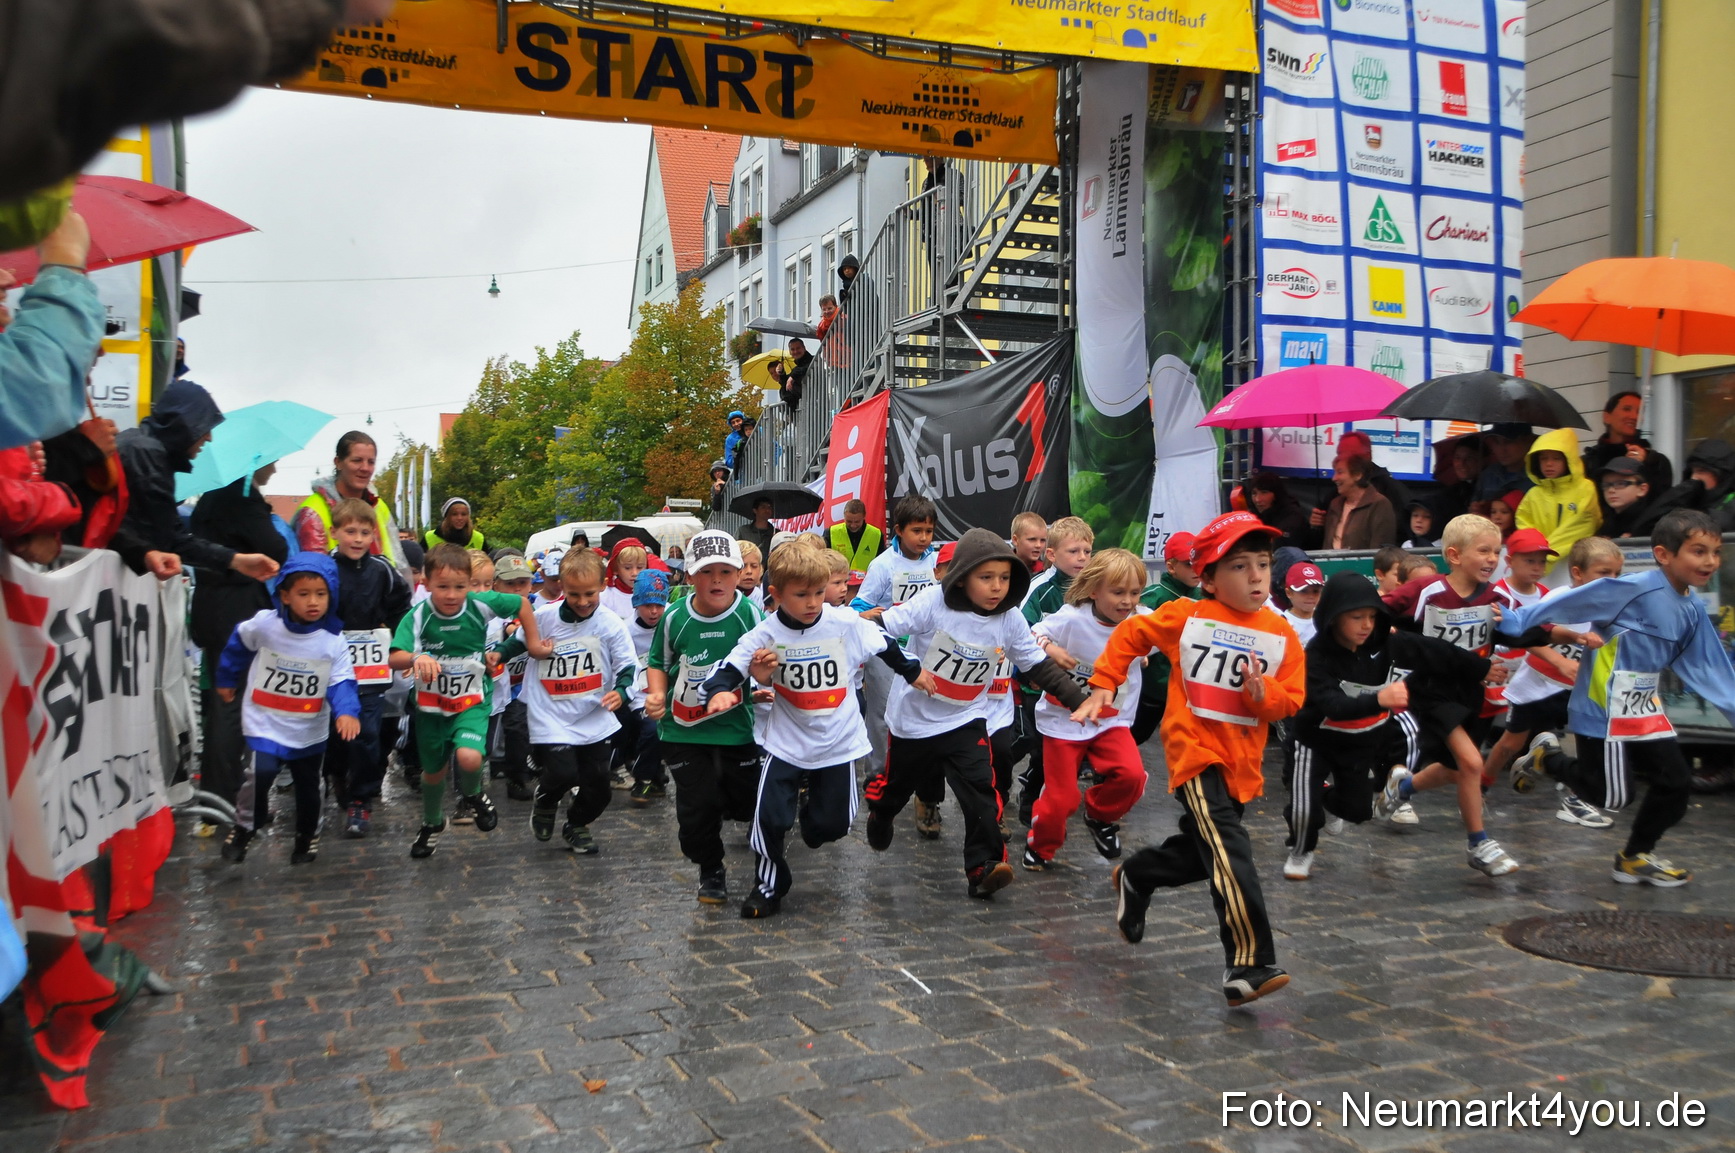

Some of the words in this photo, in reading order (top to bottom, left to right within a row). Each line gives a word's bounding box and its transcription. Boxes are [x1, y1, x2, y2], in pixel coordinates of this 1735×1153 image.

[1010, 0, 1120, 18] Neumarkter
[1126, 4, 1207, 28] Stadtlauf
[368, 44, 458, 70] Stadtlauf
[1267, 47, 1301, 72] swn
[1353, 50, 1385, 79] RUND
[514, 22, 814, 119] START
[1353, 76, 1389, 100] SCHAU
[861, 99, 953, 121] Neumarkter
[958, 108, 1025, 129] Stadtlauf
[1356, 151, 1396, 164] Neumarkter
[1428, 150, 1485, 168] HACKNER
[1436, 140, 1485, 155] INTERSPORT
[1350, 158, 1404, 178] Lammsbräu
[1103, 137, 1117, 241] Neumarkter
[1112, 113, 1133, 259] Lammsbräu
[1292, 210, 1308, 221] MAX
[1312, 213, 1338, 223] BÖGL
[1425, 215, 1490, 242] Charivari
[1267, 273, 1309, 284] GERHART
[1289, 283, 1316, 293] JANIG
[1372, 300, 1402, 314] KANN
[1284, 338, 1325, 360] maxi
[893, 380, 1047, 500] Xplus1
[1267, 426, 1335, 448] Xplus1
[898, 582, 934, 602] 72
[1213, 628, 1256, 647] BOCK
[1433, 622, 1487, 648] 7219
[350, 643, 383, 665] 315
[554, 642, 578, 653] OCK
[785, 646, 821, 657] BOCK
[546, 652, 595, 678] 7074
[777, 659, 839, 690] 7309
[933, 648, 990, 684] 7172
[262, 666, 320, 697] 7258
[554, 681, 587, 692] Maxim
